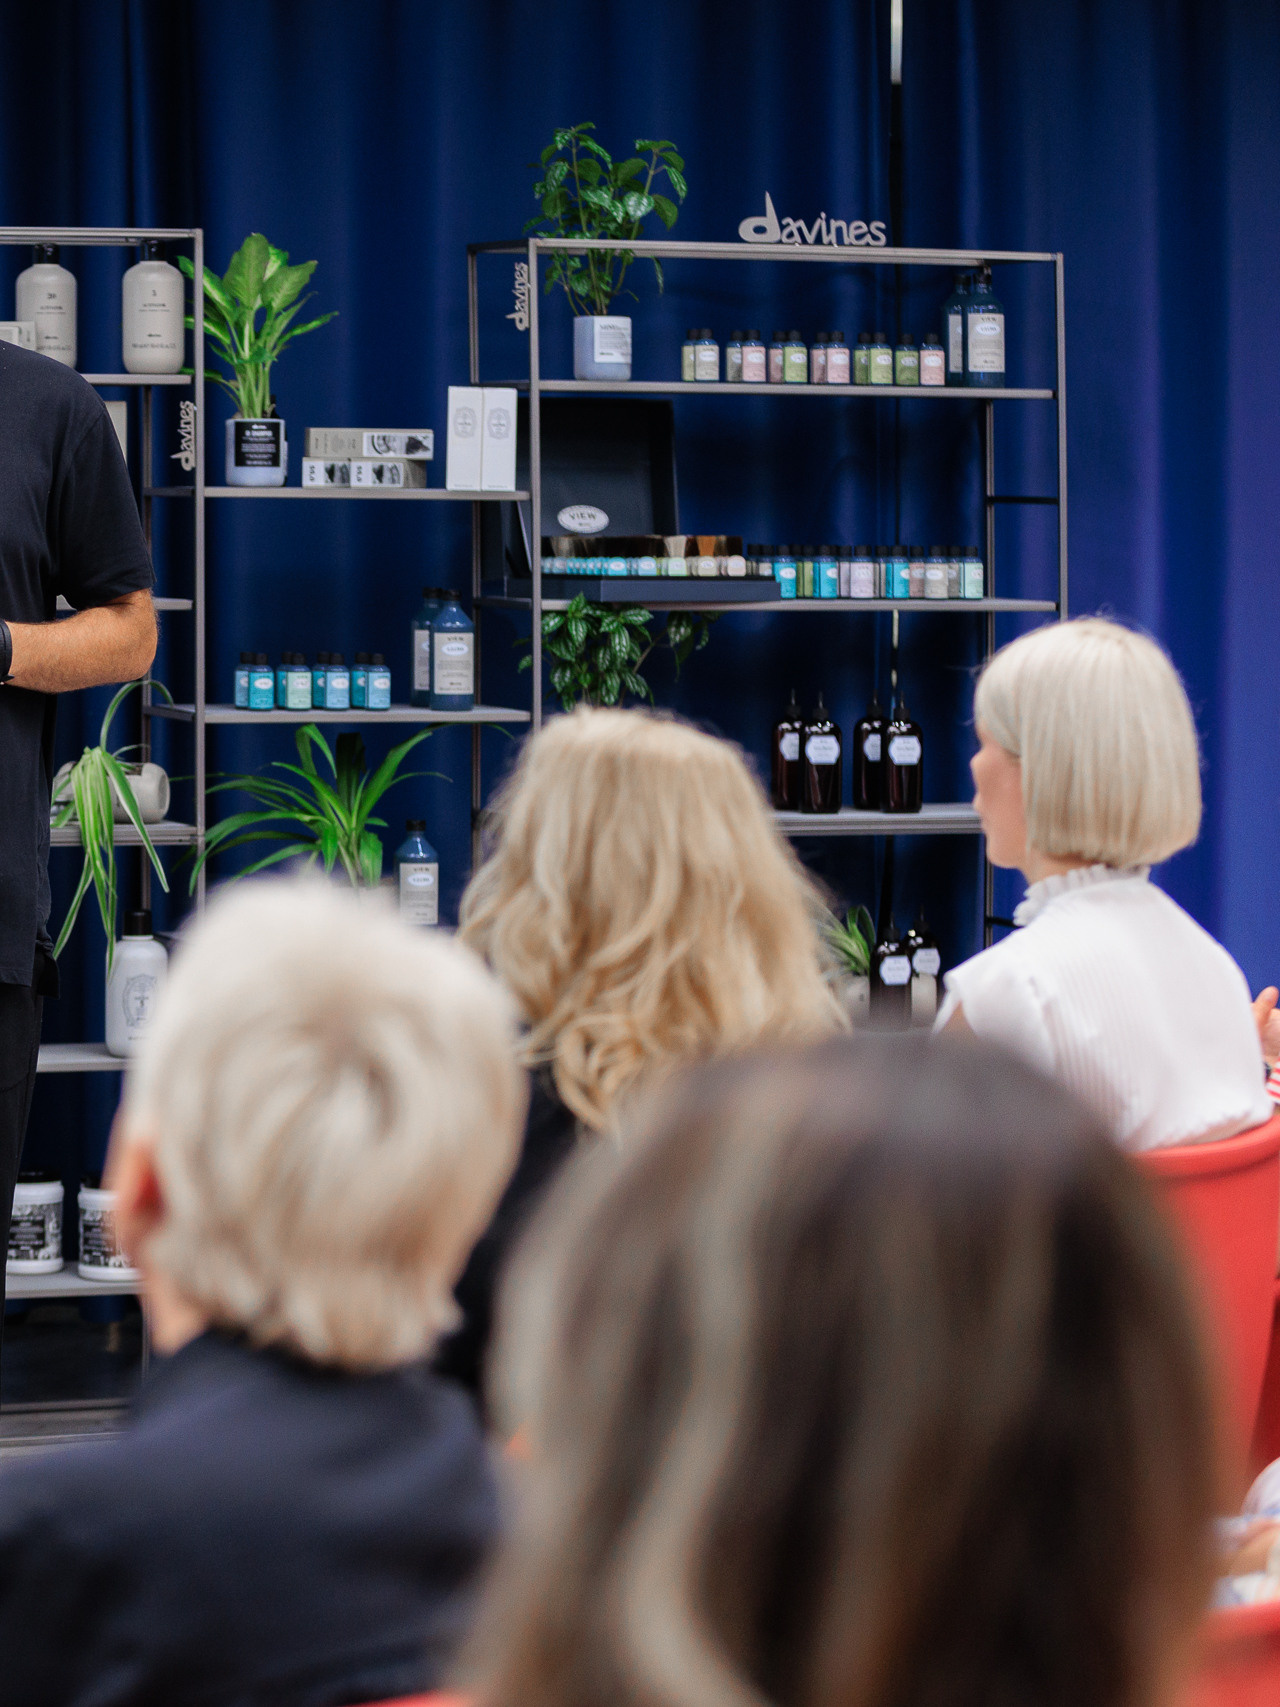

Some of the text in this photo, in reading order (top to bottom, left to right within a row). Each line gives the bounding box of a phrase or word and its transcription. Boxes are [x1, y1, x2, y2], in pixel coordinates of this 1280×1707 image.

[738, 190, 886, 247] davines
[505, 262, 530, 331] davines
[170, 400, 196, 471] davines
[569, 512, 597, 520] VIEW
